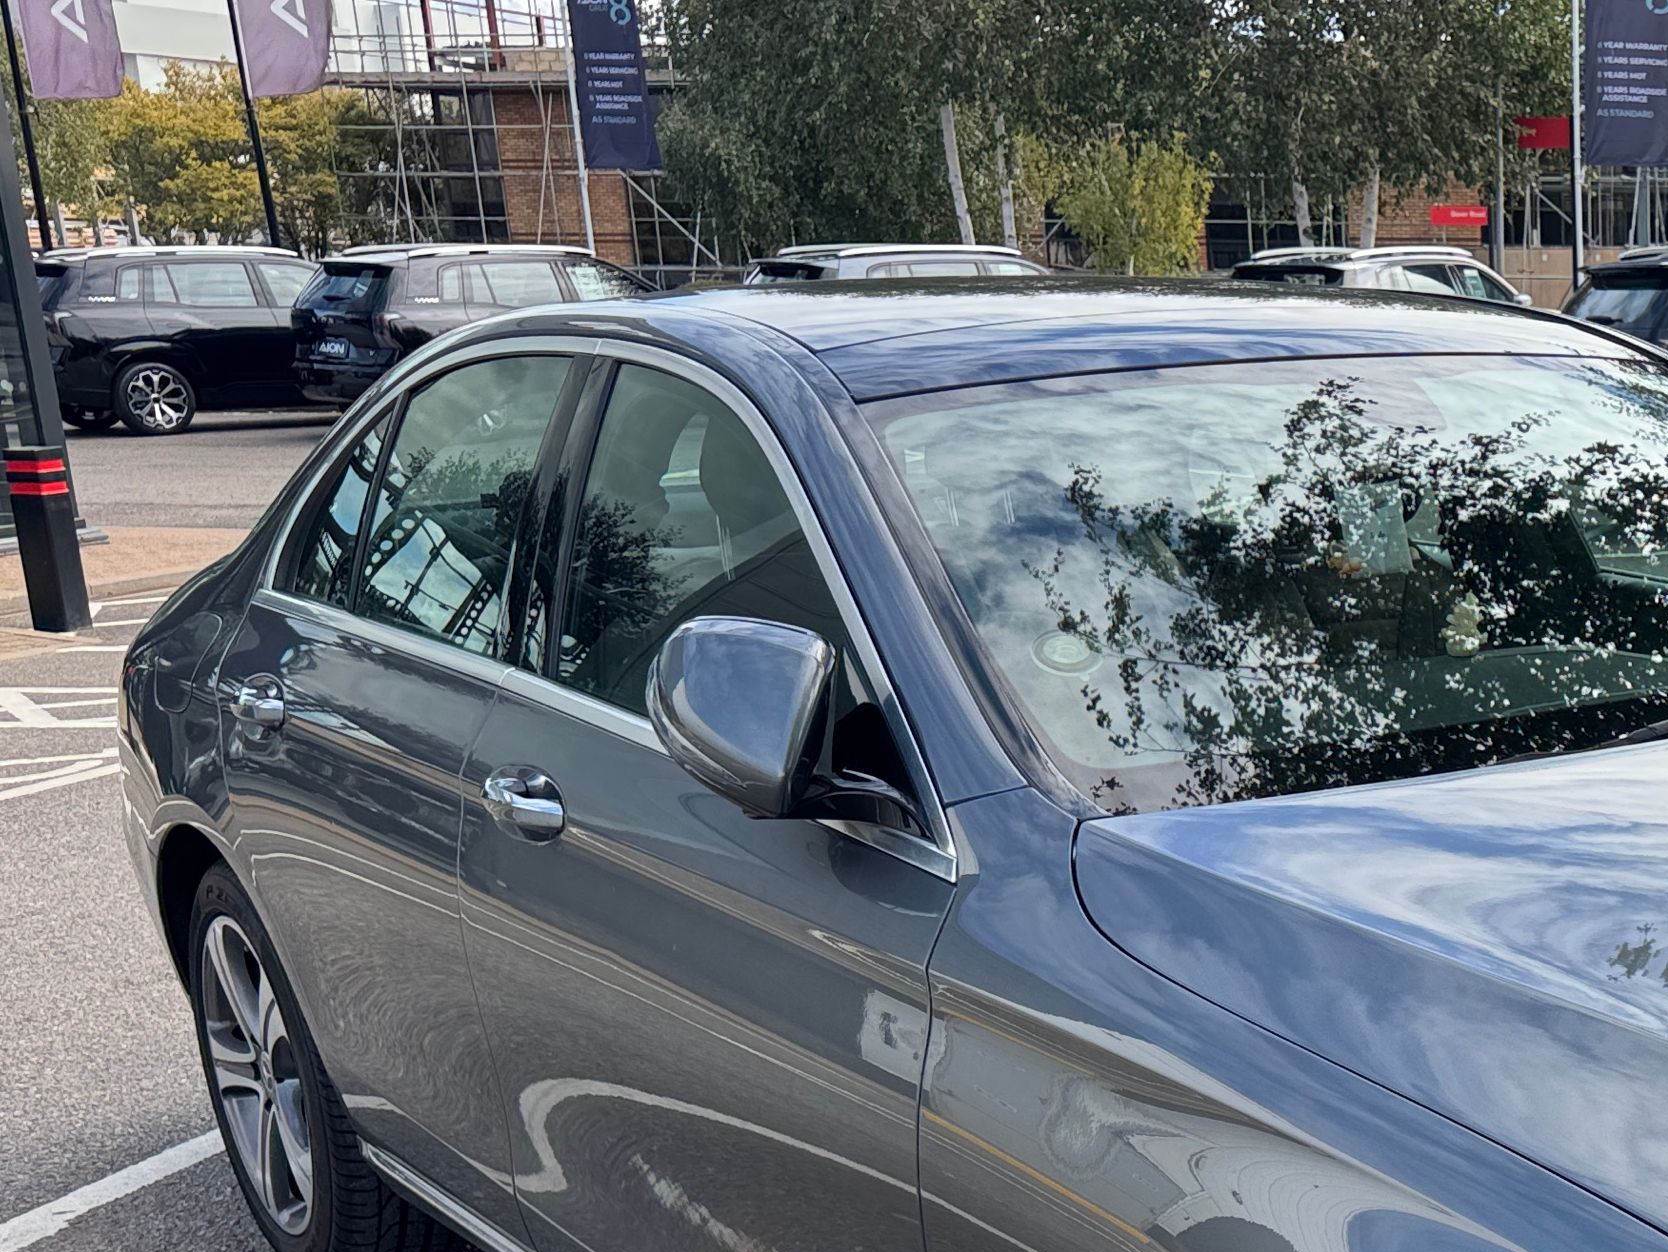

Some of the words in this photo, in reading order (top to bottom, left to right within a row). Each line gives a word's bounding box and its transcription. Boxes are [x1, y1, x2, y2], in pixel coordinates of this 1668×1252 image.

[1626, 42, 1668, 51] WARRANTY
[1603, 56, 1628, 64] YEARS
[1629, 57, 1668, 66] SERVICING
[1603, 71, 1628, 79] YEARS
[1603, 86, 1628, 94] YEARS
[1629, 87, 1668, 96] ROADSIDE
[1602, 94, 1648, 104] ASSISTANCE
[1596, 108, 1608, 117] AS
[1610, 109, 1654, 119] STANDARD
[319, 342, 345, 354] AION
